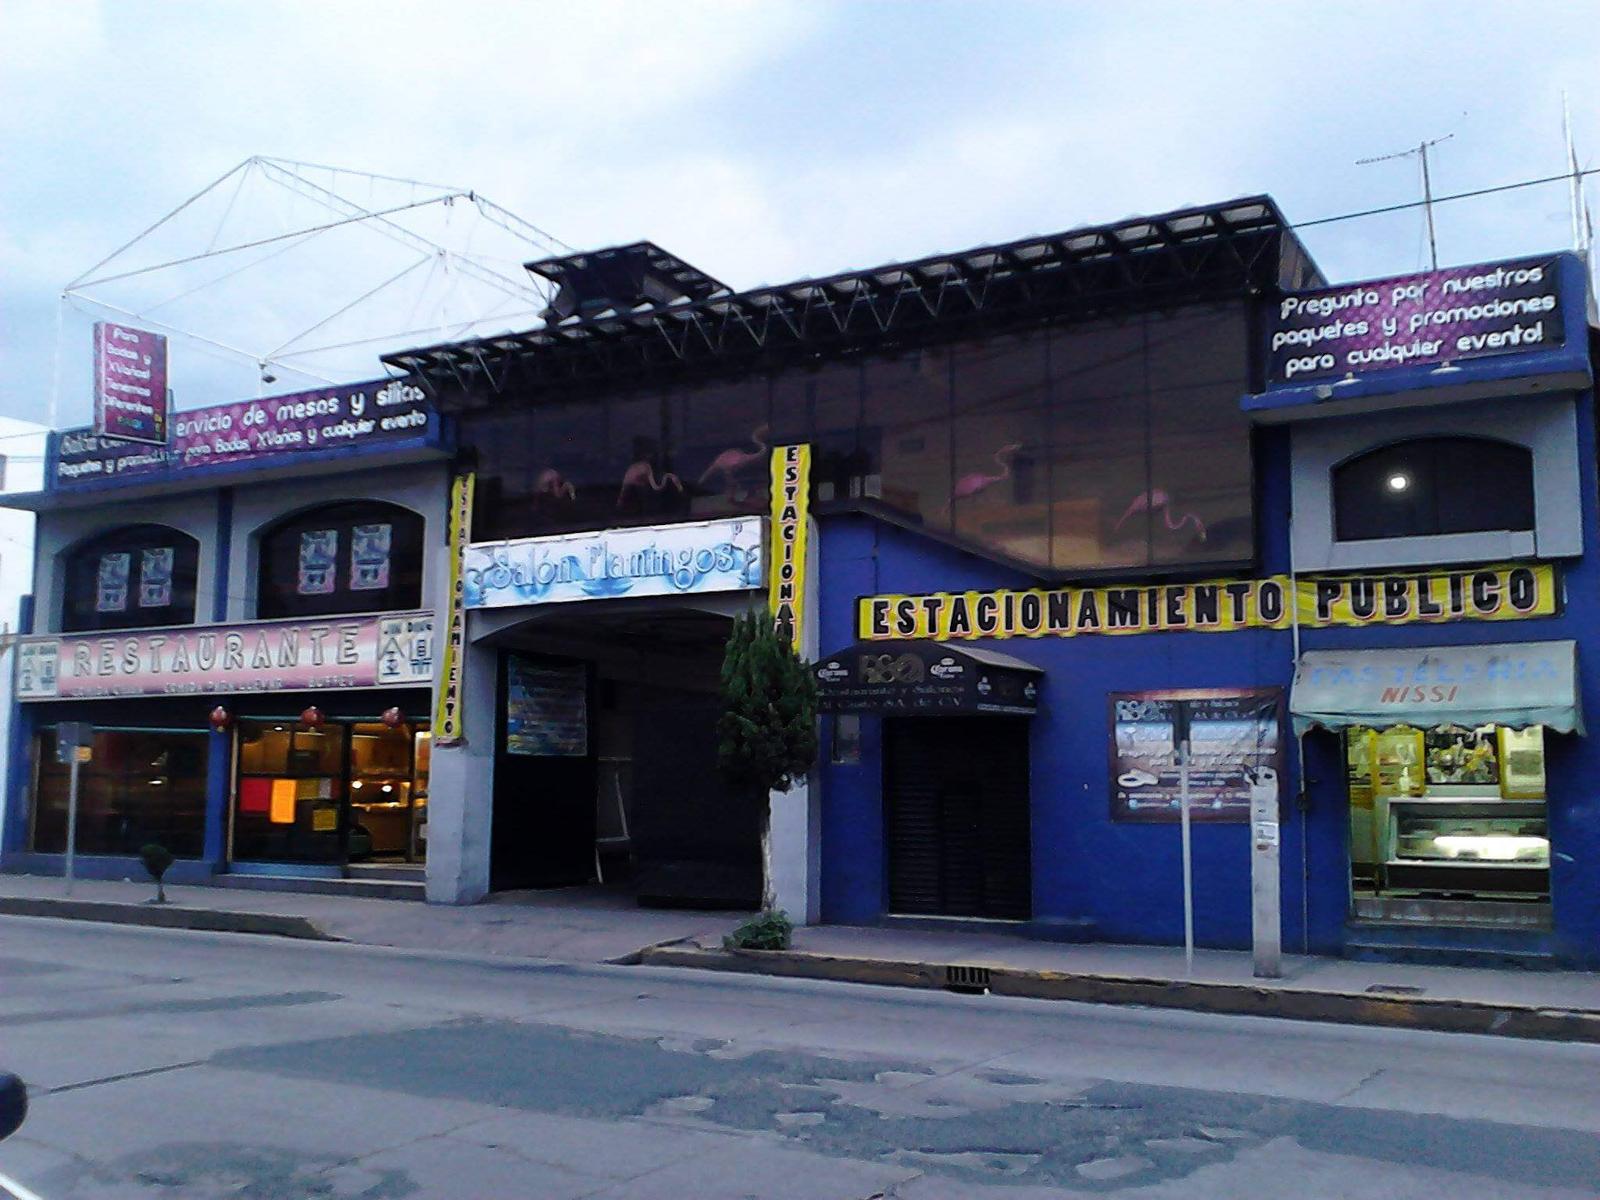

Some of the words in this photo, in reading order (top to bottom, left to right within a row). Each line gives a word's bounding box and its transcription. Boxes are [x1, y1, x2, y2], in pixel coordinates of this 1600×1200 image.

[1392, 283, 1428, 307] por
[1443, 266, 1544, 295] nuestros
[1272, 319, 1369, 351] paquetes
[1382, 317, 1397, 337] y
[1409, 294, 1556, 333] promociones
[1286, 353, 1335, 378] para
[1347, 337, 1444, 365] cualquier
[1456, 321, 1544, 351] evento!
[176, 415, 232, 437] ervicio
[243, 405, 266, 426] de
[276, 395, 340, 421] mesas
[351, 392, 366, 416] y
[376, 381, 425, 406] sillas
[307, 427, 317, 445] y
[322, 418, 377, 440] cualquier
[380, 409, 427, 431] evento
[491, 549, 573, 589] Salón
[585, 541, 735, 590] Flamingos
[872, 580, 1284, 635] ESTACIONAMIENTO
[1315, 565, 1539, 619] PUBLICO
[73, 623, 361, 677] RESTAURANTE
[1380, 686, 1458, 704] NISSI
